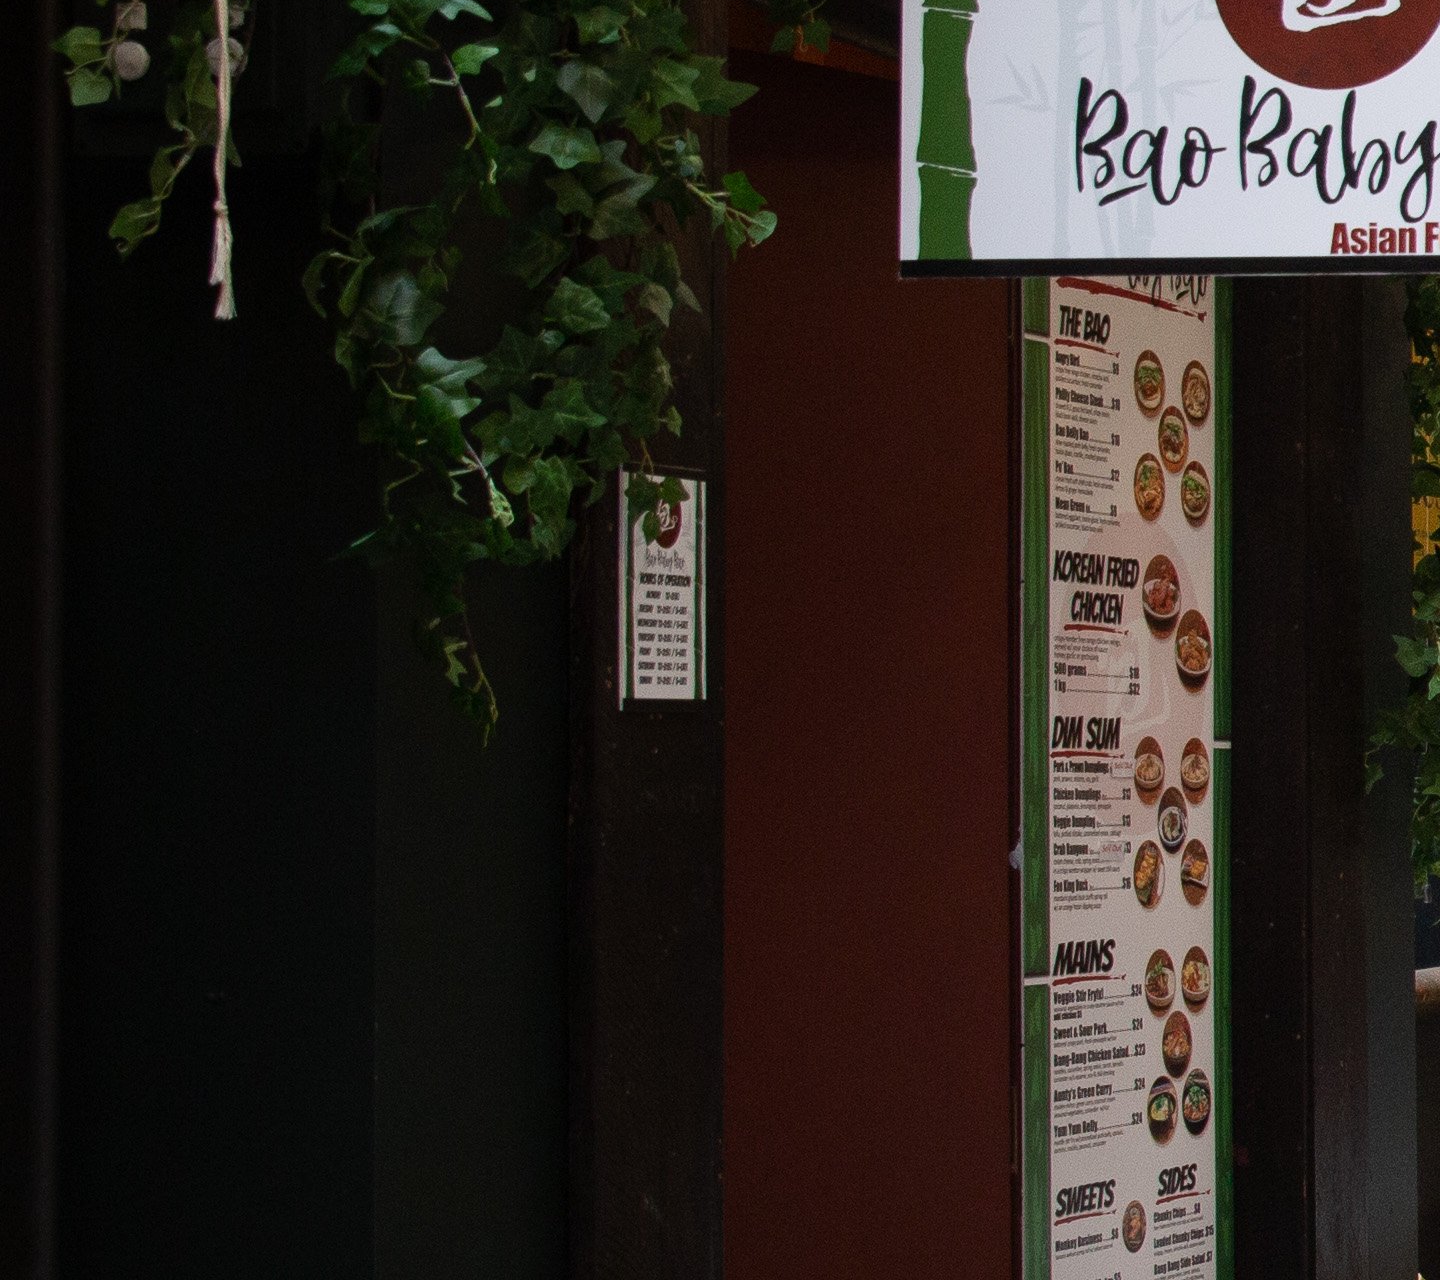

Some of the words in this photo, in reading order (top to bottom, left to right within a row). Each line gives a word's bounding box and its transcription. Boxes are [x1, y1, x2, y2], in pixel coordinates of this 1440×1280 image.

[1074, 75, 1225, 206] Bao
[1329, 220, 1418, 254] Asian
[1060, 305, 1083, 338] THE
[1083, 310, 1111, 344] BAO
[1053, 549, 1105, 587] KOREAN
[1106, 556, 1140, 589] FRIED
[1071, 592, 1124, 625] CHICKEN
[1067, 665, 1087, 677] grams
[1051, 715, 1084, 750] DIM
[1086, 716, 1122, 751] SUM
[1053, 938, 1116, 977] MAINS
[1054, 1027, 1072, 1040] Sweet
[1079, 1024, 1093, 1037] Sour
[1094, 1022, 1107, 1036] Pork
[1054, 1052, 1087, 1067] Bang-Bang
[1088, 1049, 1111, 1062] Chicken
[1113, 1045, 1129, 1059] Salad
[1077, 1086, 1095, 1099] Green
[1096, 1084, 1112, 1096] Curry
[1158, 1163, 1198, 1197] SIDES
[1055, 1179, 1116, 1217] SWEETS
[1173, 1207, 1186, 1219] Chips
[1191, 1228, 1204, 1240] Chips
